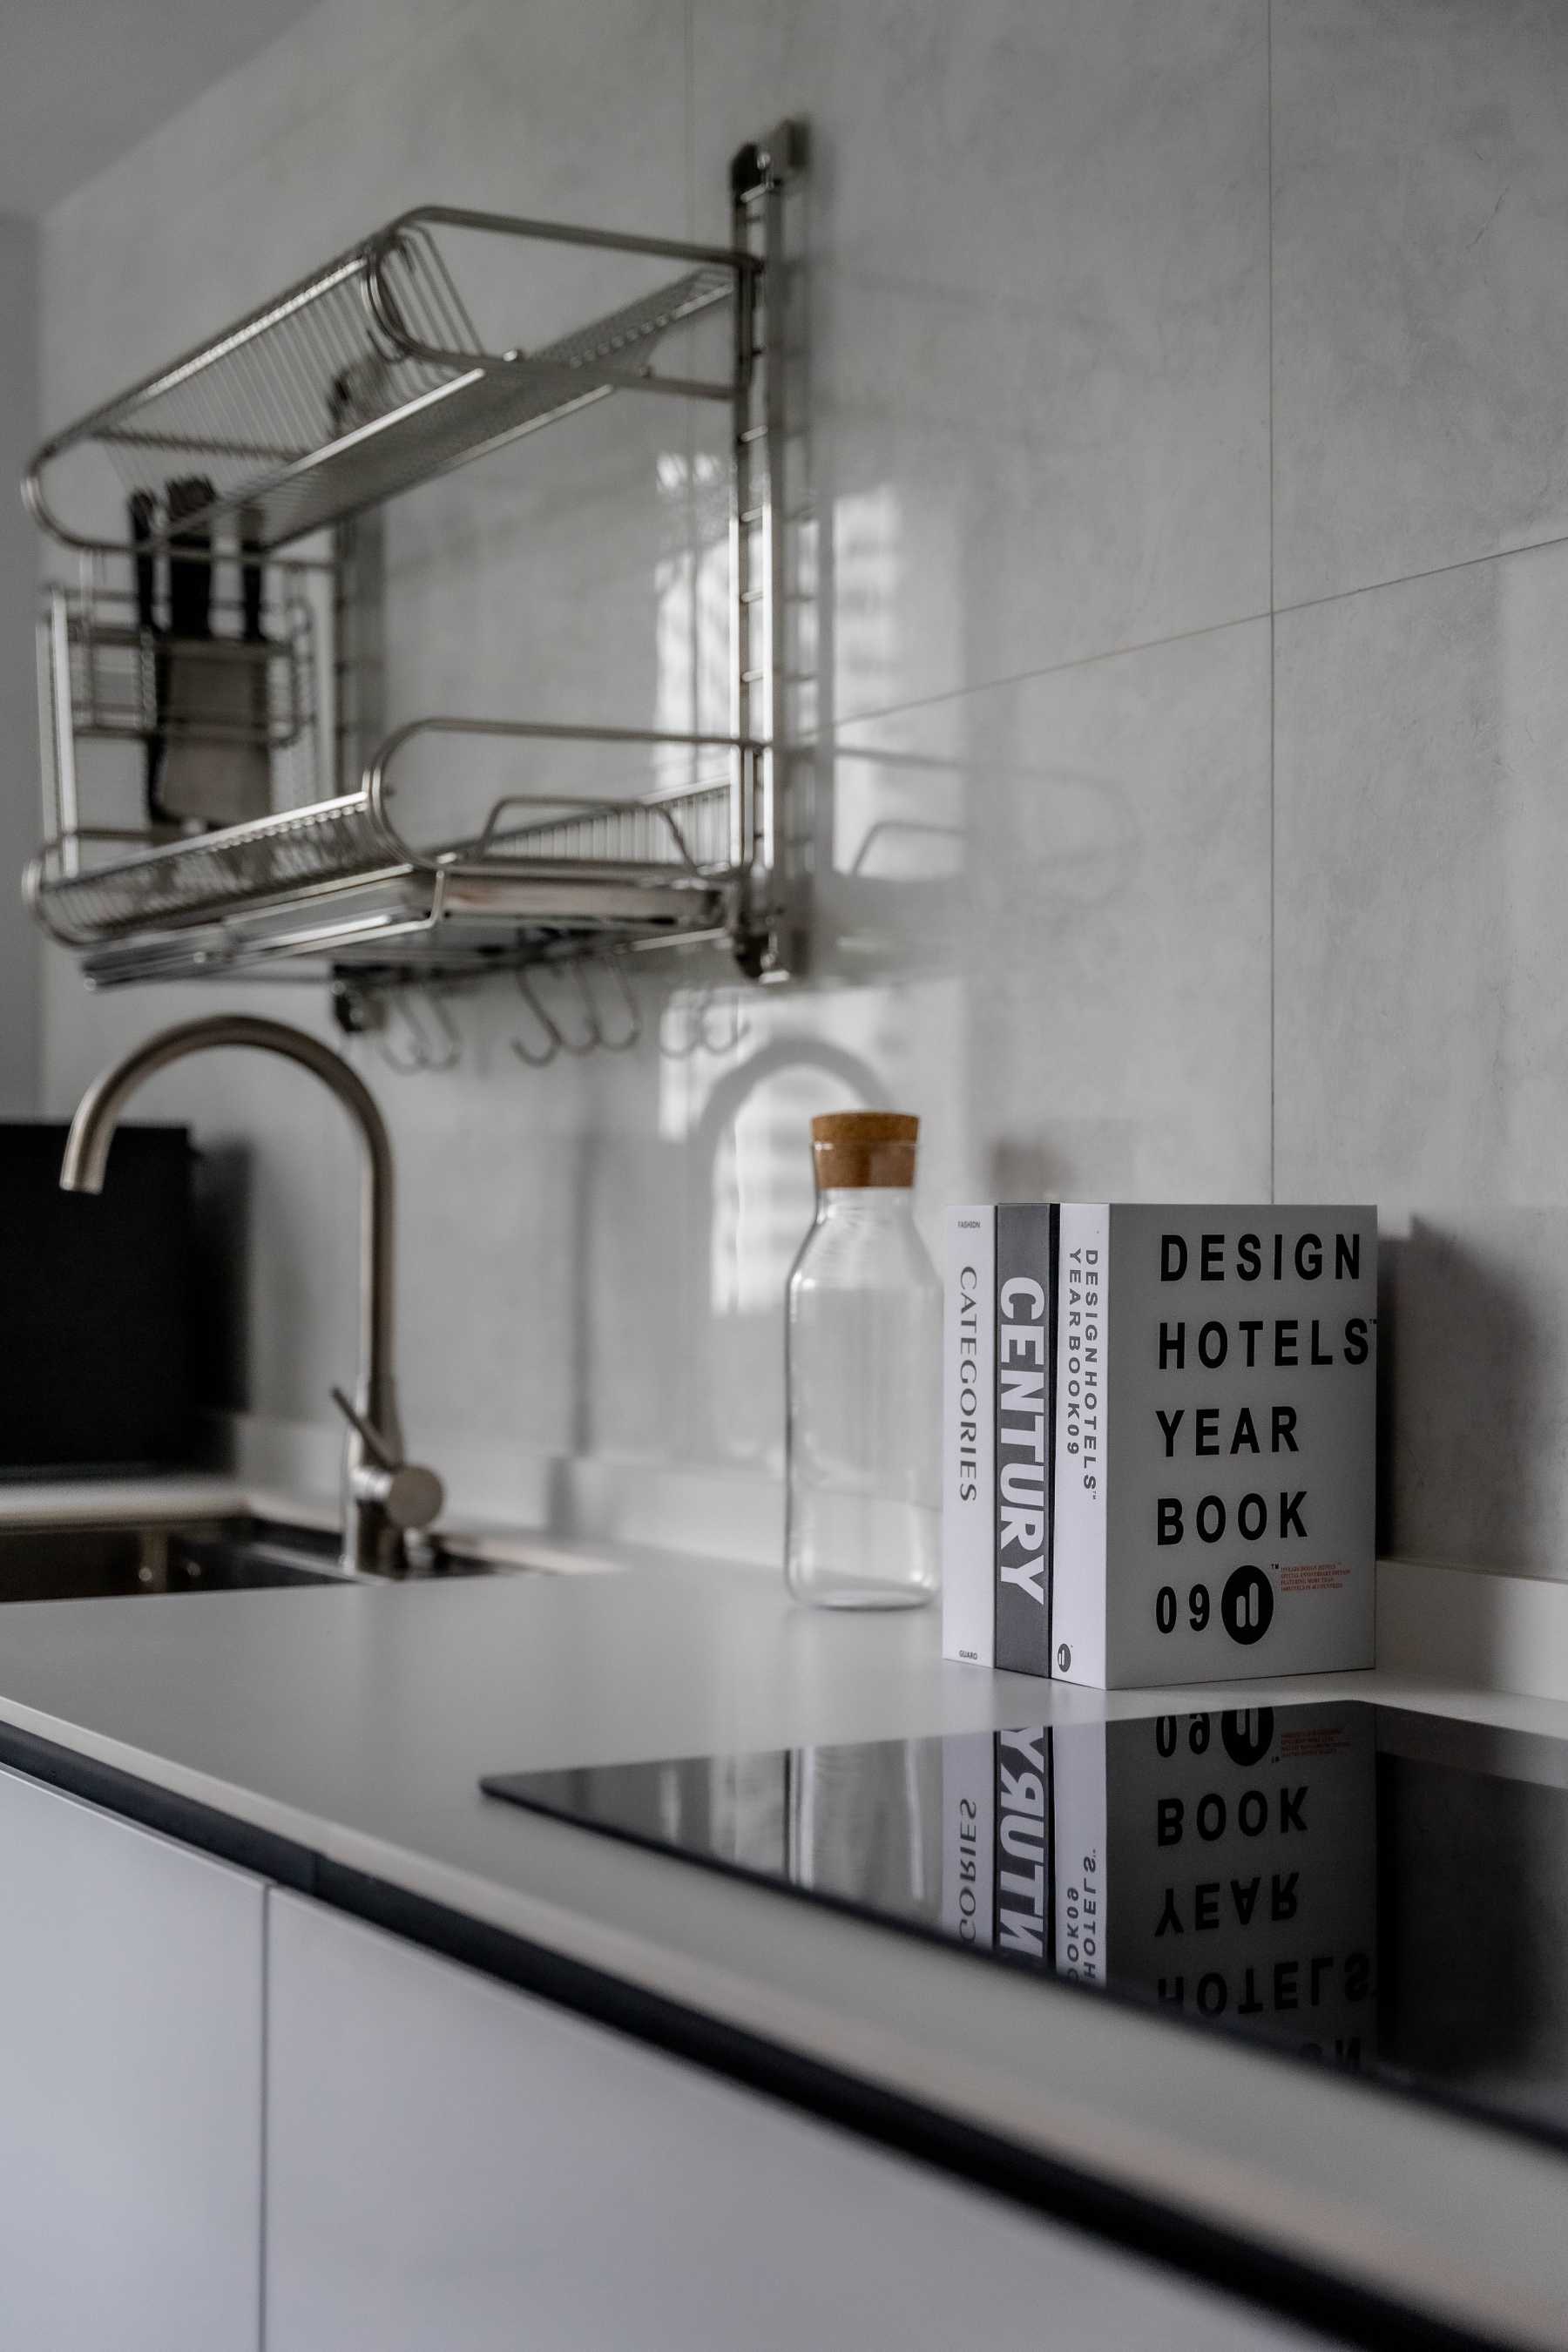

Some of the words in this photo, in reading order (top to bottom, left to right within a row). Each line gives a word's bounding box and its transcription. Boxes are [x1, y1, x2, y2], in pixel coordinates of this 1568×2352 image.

[1160, 1233, 1360, 1282] DESIGN
[959, 1266, 977, 1502] CATEGORIES
[1000, 1277, 1045, 1605] CENTURY
[1155, 1405, 1300, 1457] YEAR
[1157, 1490, 1308, 1546] BOOK
[1155, 1583, 1211, 1634] 09
